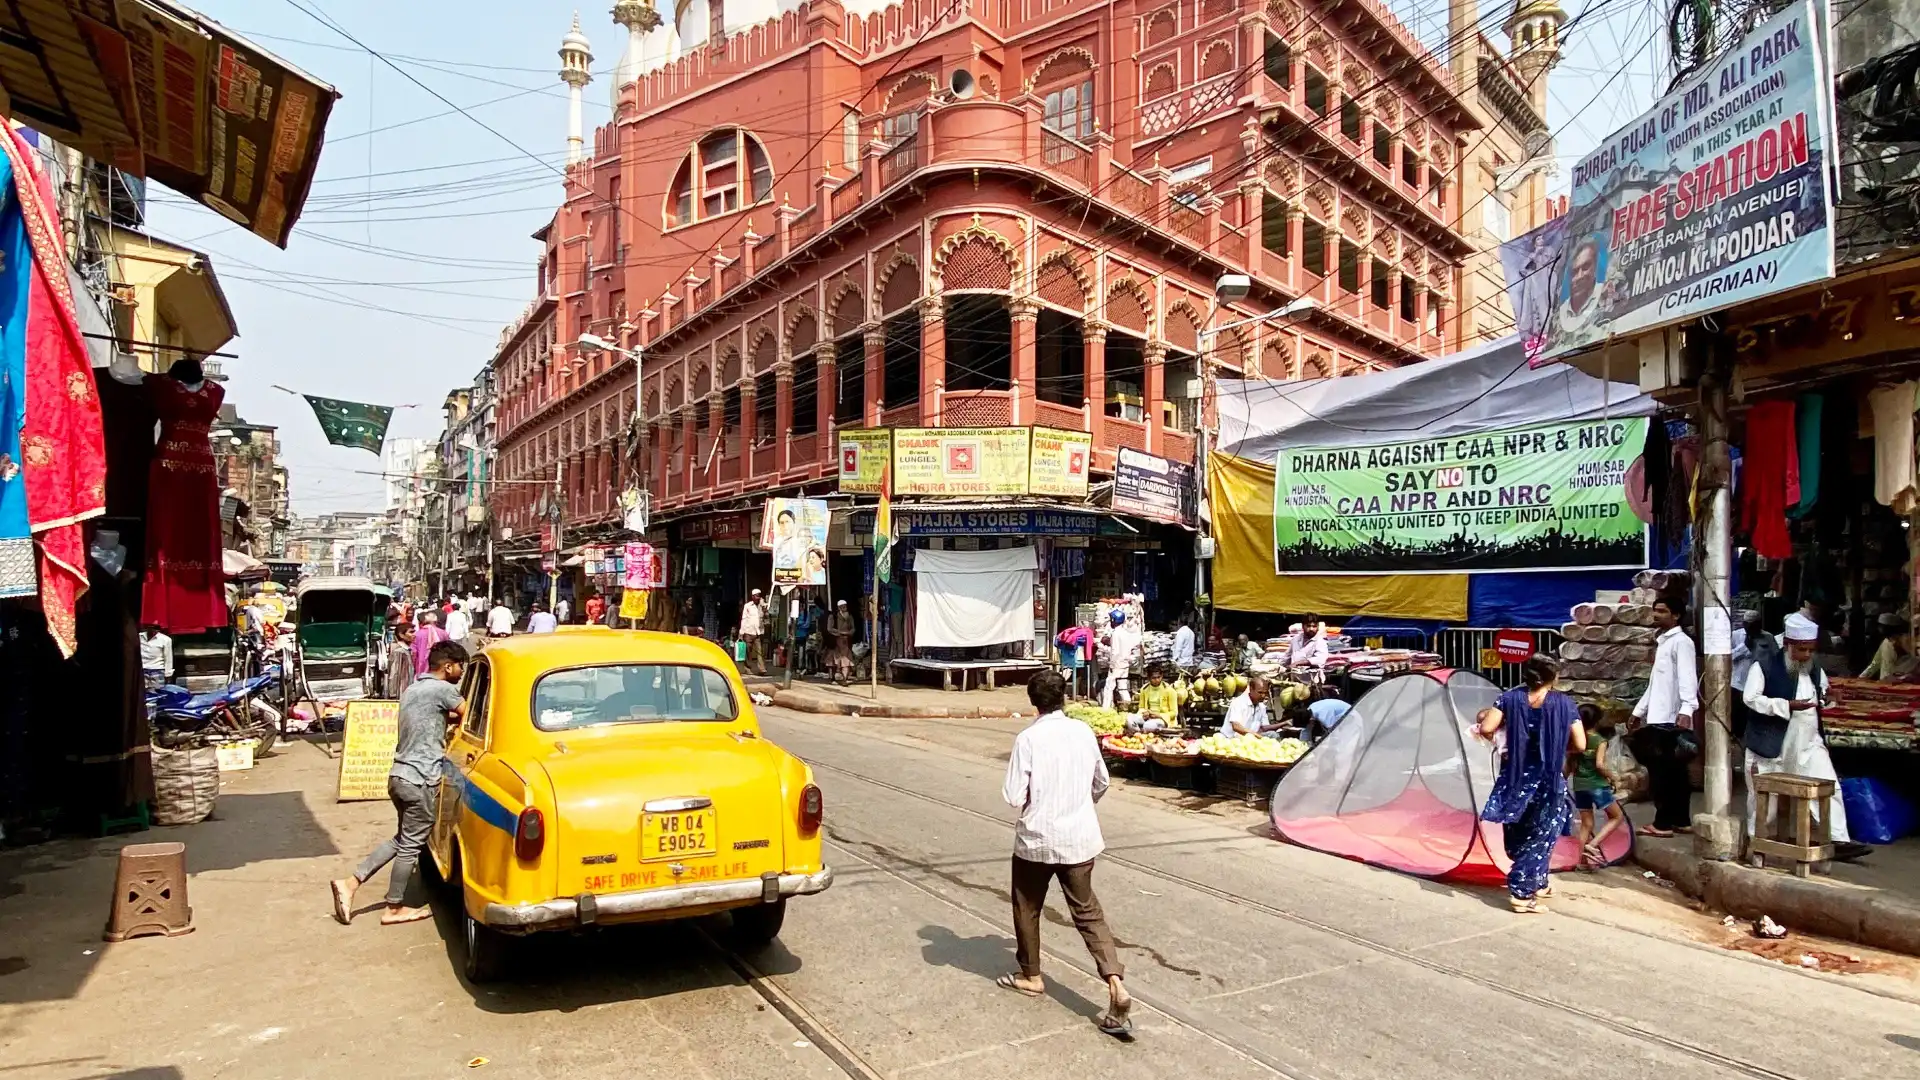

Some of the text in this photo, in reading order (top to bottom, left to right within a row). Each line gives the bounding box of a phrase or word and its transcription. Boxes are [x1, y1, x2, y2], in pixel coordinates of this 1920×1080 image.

[1575, 19, 1801, 187] DURGA PUJA OF MD. ALI PARK
[1666, 70, 1786, 156] (YOUTH ASSOCIATION)
[1693, 98, 1784, 162] IN THIS YEAR AT
[1610, 112, 1810, 251] FIRE STATION
[1617, 178, 1804, 269] (CHITTARANJAN AVENUE)
[1631, 211, 1796, 298] MANOJ Kr. PODDAR
[1658, 260, 1778, 315] (CHAIRMAN)
[897, 440, 940, 448] CHANK
[1035, 439, 1063, 451] CHANK
[1292, 423, 1624, 473] DHARNA AGAISNT CAA NPR & NRC
[1385, 463, 1497, 492] SAY NO TO
[1578, 459, 1625, 475] HUM SAB
[910, 483, 946, 493] HAJRA
[950, 483, 991, 493] STORES
[1291, 484, 1326, 494] HUM SAB
[1569, 473, 1625, 489] HINDUSTA
[1284, 495, 1331, 506] HINDUSTANI
[1337, 484, 1551, 514] CAA NPR AND NRC
[912, 512, 1028, 527] HAJRA STORES
[1035, 514, 1097, 528] HAJRA STORES
[1297, 519, 1341, 532] BENGAL
[1346, 516, 1393, 531] STANDS
[1396, 514, 1445, 529] UNITED
[1453, 512, 1471, 526] TO
[1475, 510, 1511, 525] KEEP
[1562, 502, 1620, 520] UNITED
[1508, 648, 1529, 656] ENTRY
[358, 723, 396, 734] STOR
[661, 814, 704, 833] WB 04
[658, 832, 706, 853] E9052
[584, 861, 749, 890] SAFE DRIVE SAVE LIFE
